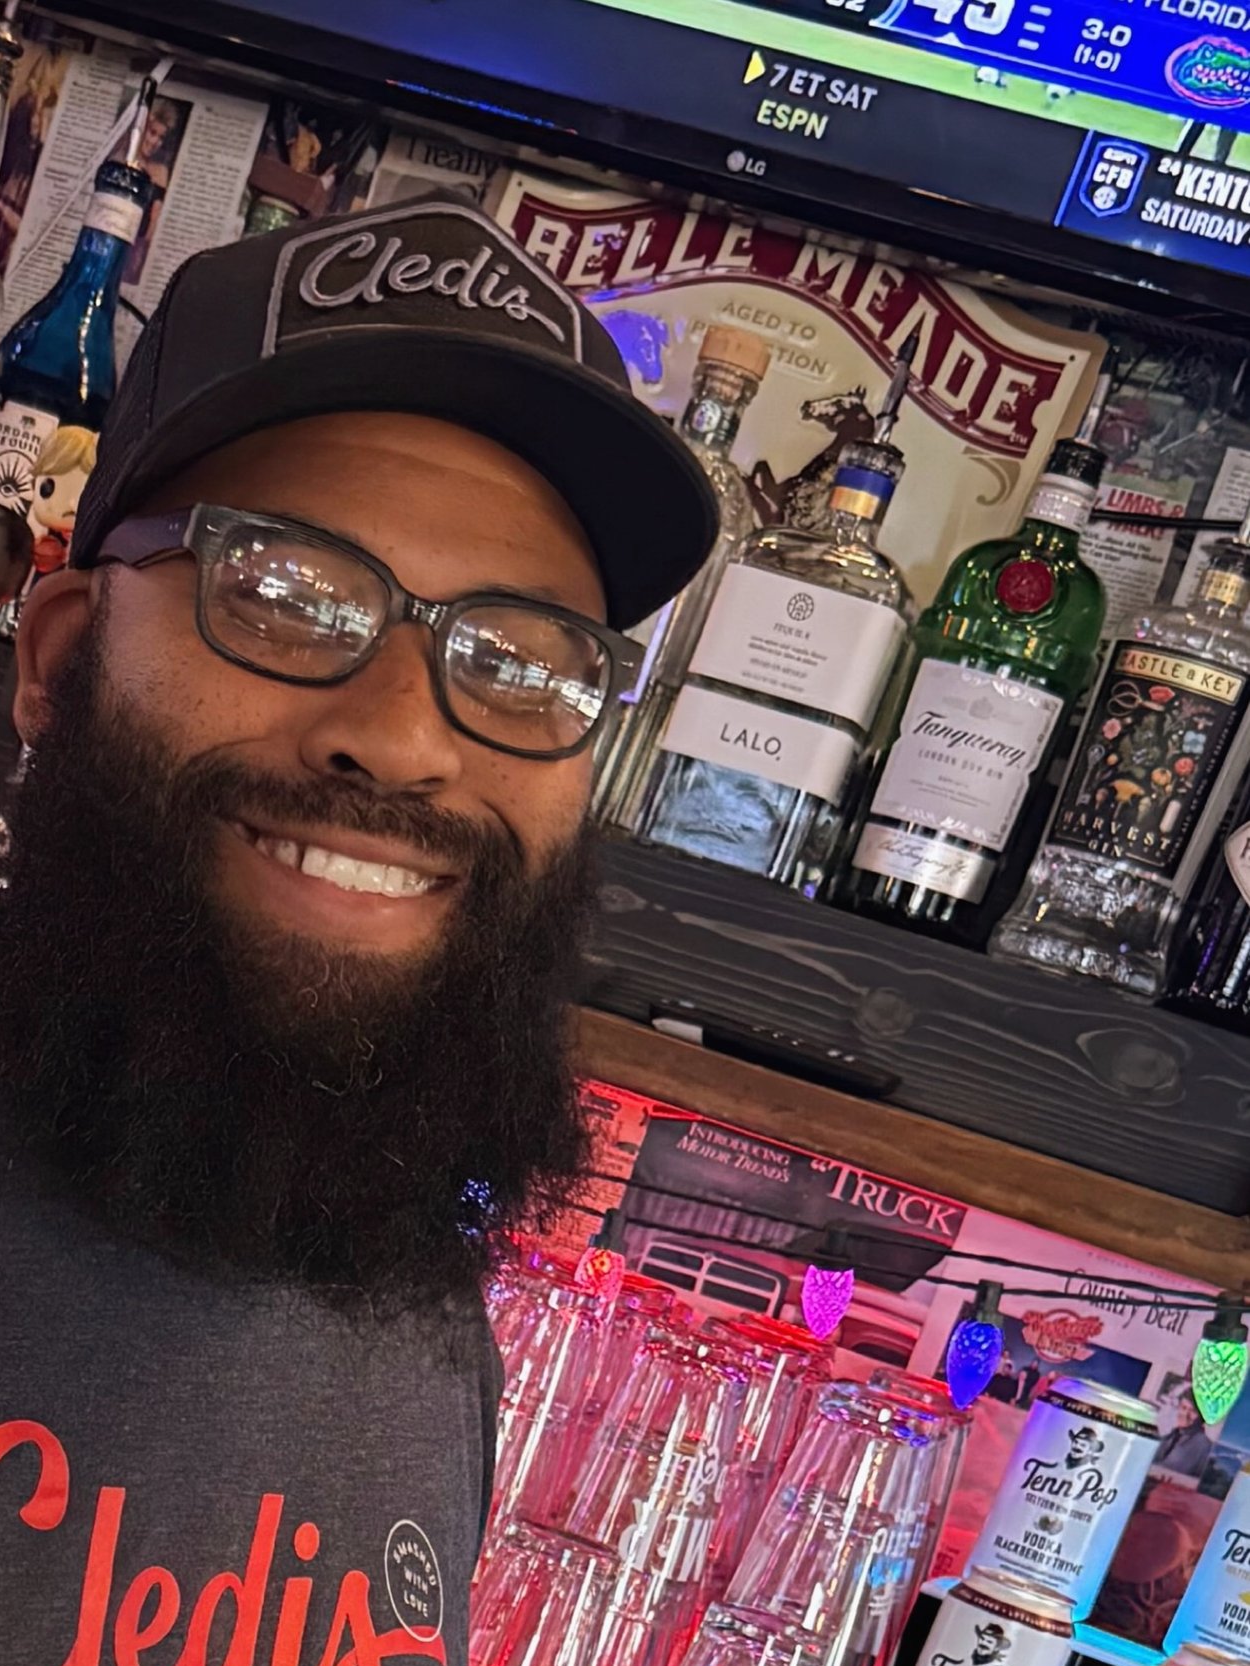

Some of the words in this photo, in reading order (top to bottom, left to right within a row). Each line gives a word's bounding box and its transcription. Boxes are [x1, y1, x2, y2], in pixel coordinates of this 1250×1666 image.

[769, 63, 789, 87] 7
[788, 68, 826, 98] ET
[825, 79, 878, 111] SAT
[756, 99, 829, 139] ESPN
[745, 158, 766, 176] LG
[1092, 161, 1134, 190] CFB
[1141, 197, 1249, 246] SATURDAY
[300, 232, 566, 343] Cledis
[721, 302, 781, 329] AGED
[788, 320, 816, 341] TO
[787, 242, 1038, 436] MEADE
[1122, 650, 1182, 679] CASTLE
[1200, 674, 1238, 696] KEY
[913, 711, 1026, 768] Tanqueray
[1063, 810, 1171, 851] HARVEST
[1088, 841, 1123, 858] GIN
[689, 1122, 790, 1166] INTRODUCING
[1021, 1458, 1073, 1498] Tenn
[1072, 1468, 1118, 1512] Pop
[994, 1535, 1052, 1567] BLACKBERRY
[1052, 1557, 1084, 1577] THYME
[1023, 1530, 1062, 1555] VODKA
[403, 1565, 429, 1596] WITH
[404, 1589, 429, 1618] LOVE
